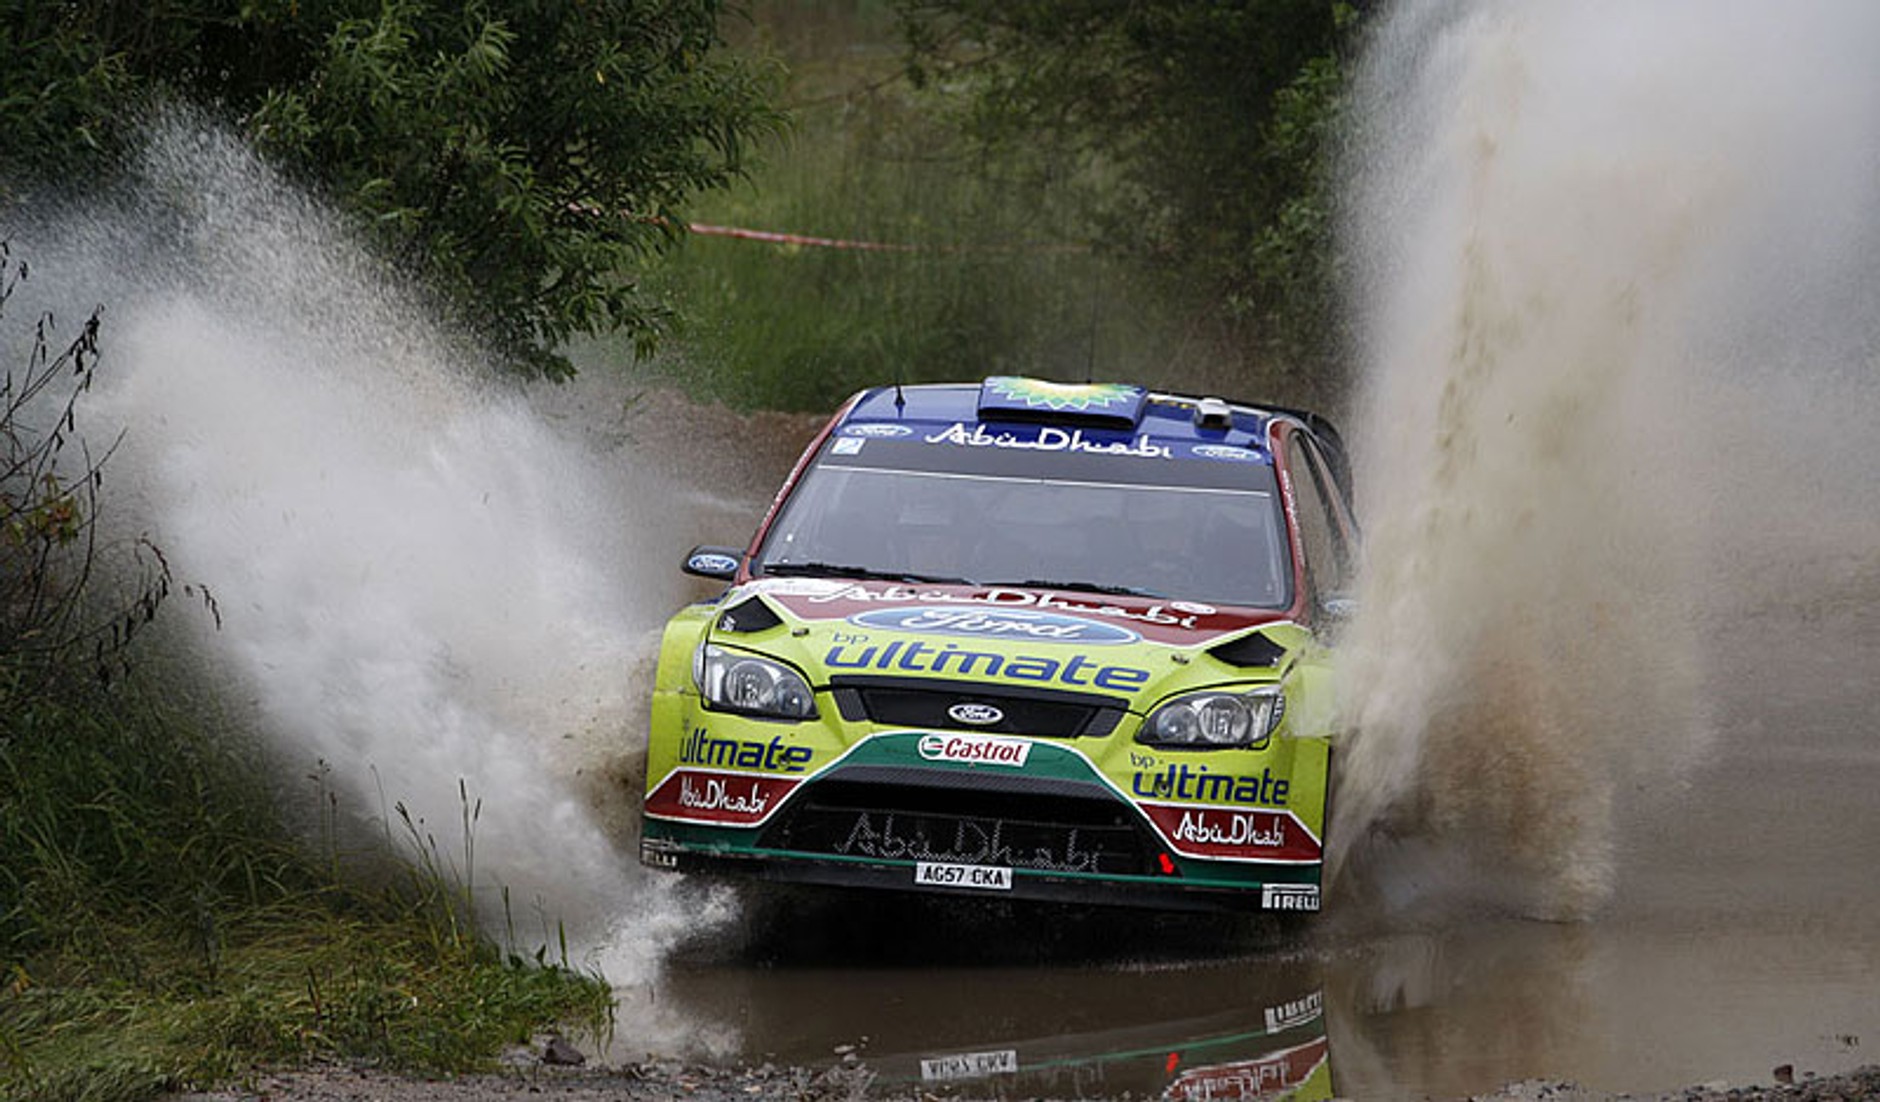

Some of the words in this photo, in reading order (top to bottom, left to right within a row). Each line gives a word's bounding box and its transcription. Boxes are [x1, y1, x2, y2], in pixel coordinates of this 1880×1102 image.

[901, 609, 1087, 638] Ford
[833, 632, 869, 645] bp
[825, 641, 1151, 693] ultimate
[957, 705, 996, 721] Ford
[945, 738, 1024, 762] Castrol
[1130, 752, 1156, 769] bp
[1133, 764, 1290, 805] ultimate
